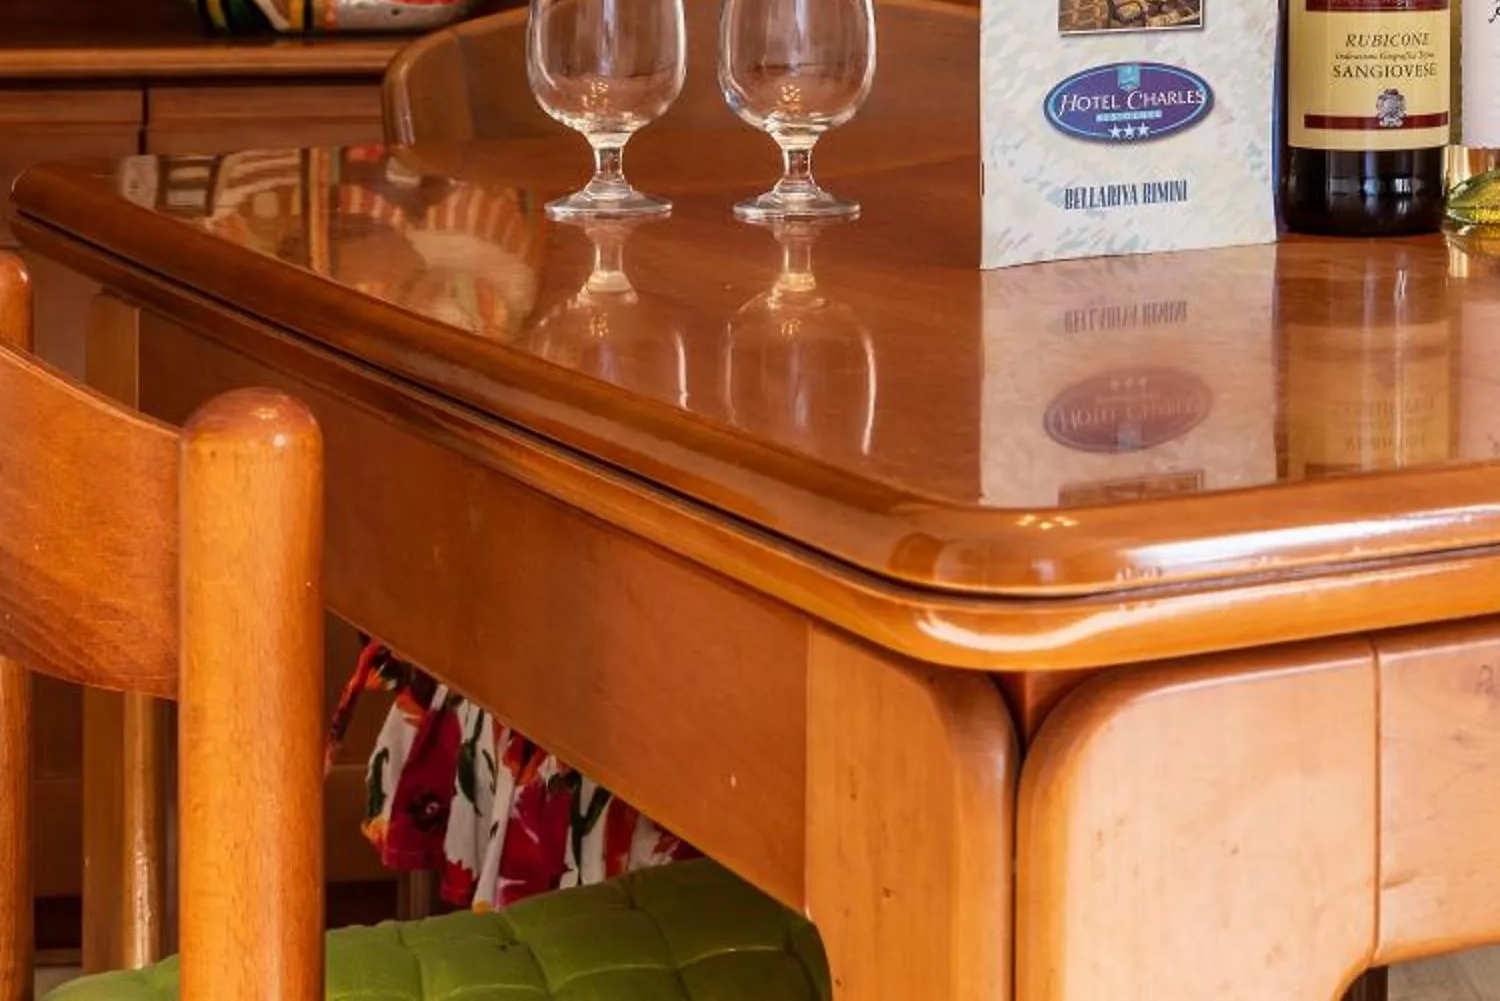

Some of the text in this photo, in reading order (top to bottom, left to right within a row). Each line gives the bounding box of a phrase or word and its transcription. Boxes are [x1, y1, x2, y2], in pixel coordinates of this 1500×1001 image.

[1345, 31, 1431, 49] RUBICONE
[1332, 62, 1438, 79] SANGIOVESE
[1126, 89, 1206, 111] CHARLES
[1063, 178, 1188, 210] BELLARIVA RIMINI
